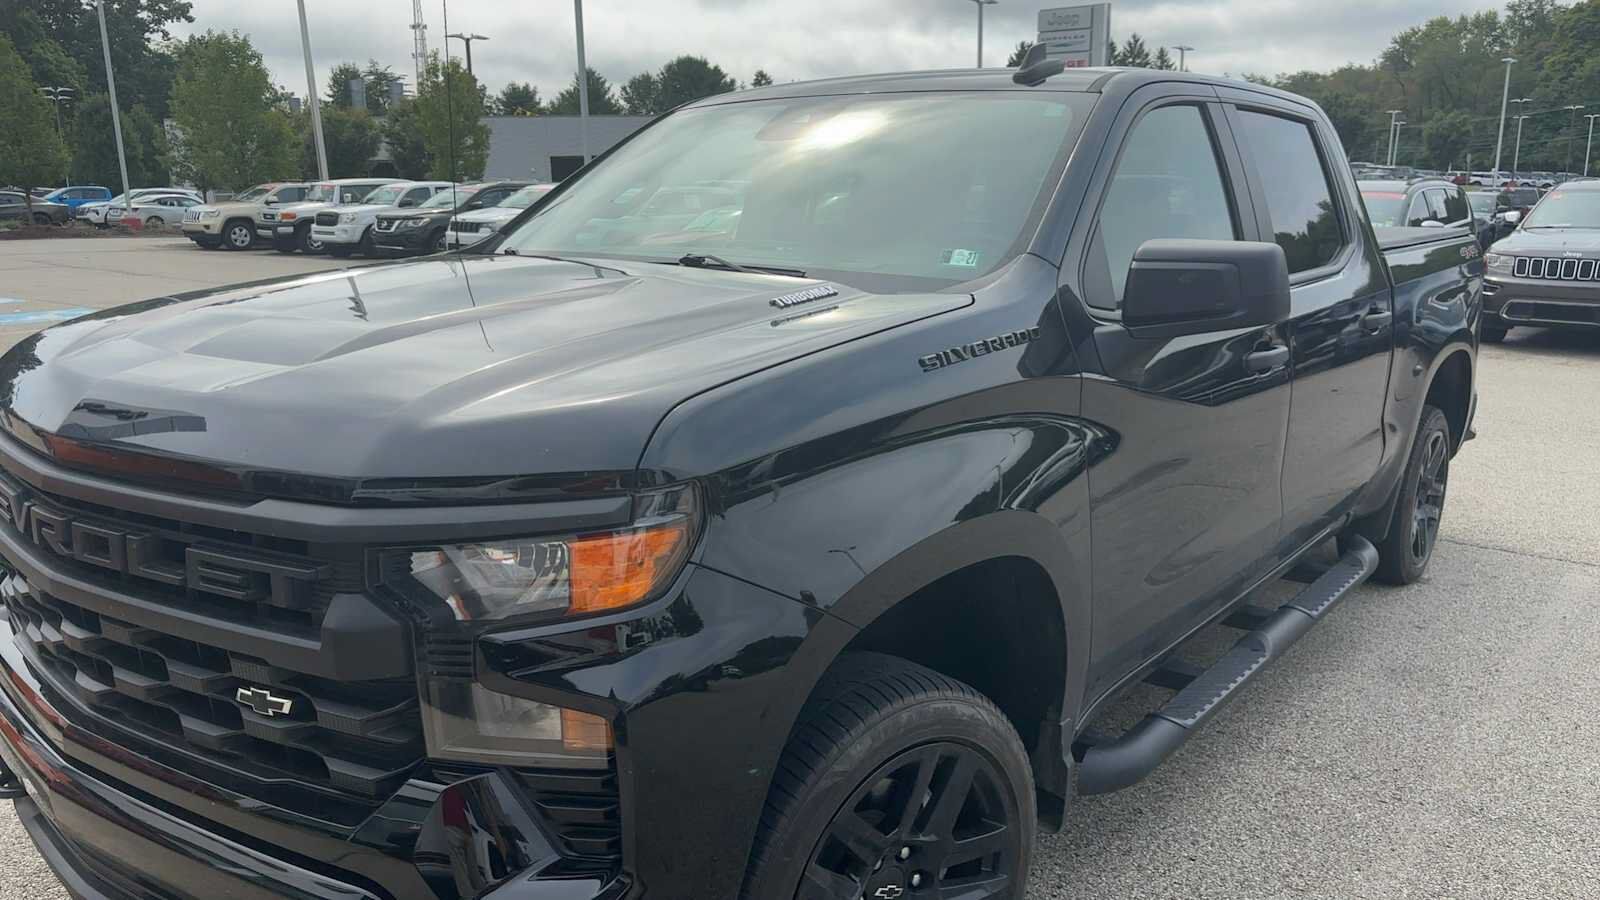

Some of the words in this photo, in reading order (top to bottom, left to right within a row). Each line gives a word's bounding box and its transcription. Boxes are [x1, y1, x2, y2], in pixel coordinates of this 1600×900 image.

[1047, 12, 1080, 27] Jeep
[966, 252, 977, 265] 27
[769, 285, 838, 309] TURBOMAX
[918, 326, 1040, 373] SILVERADO
